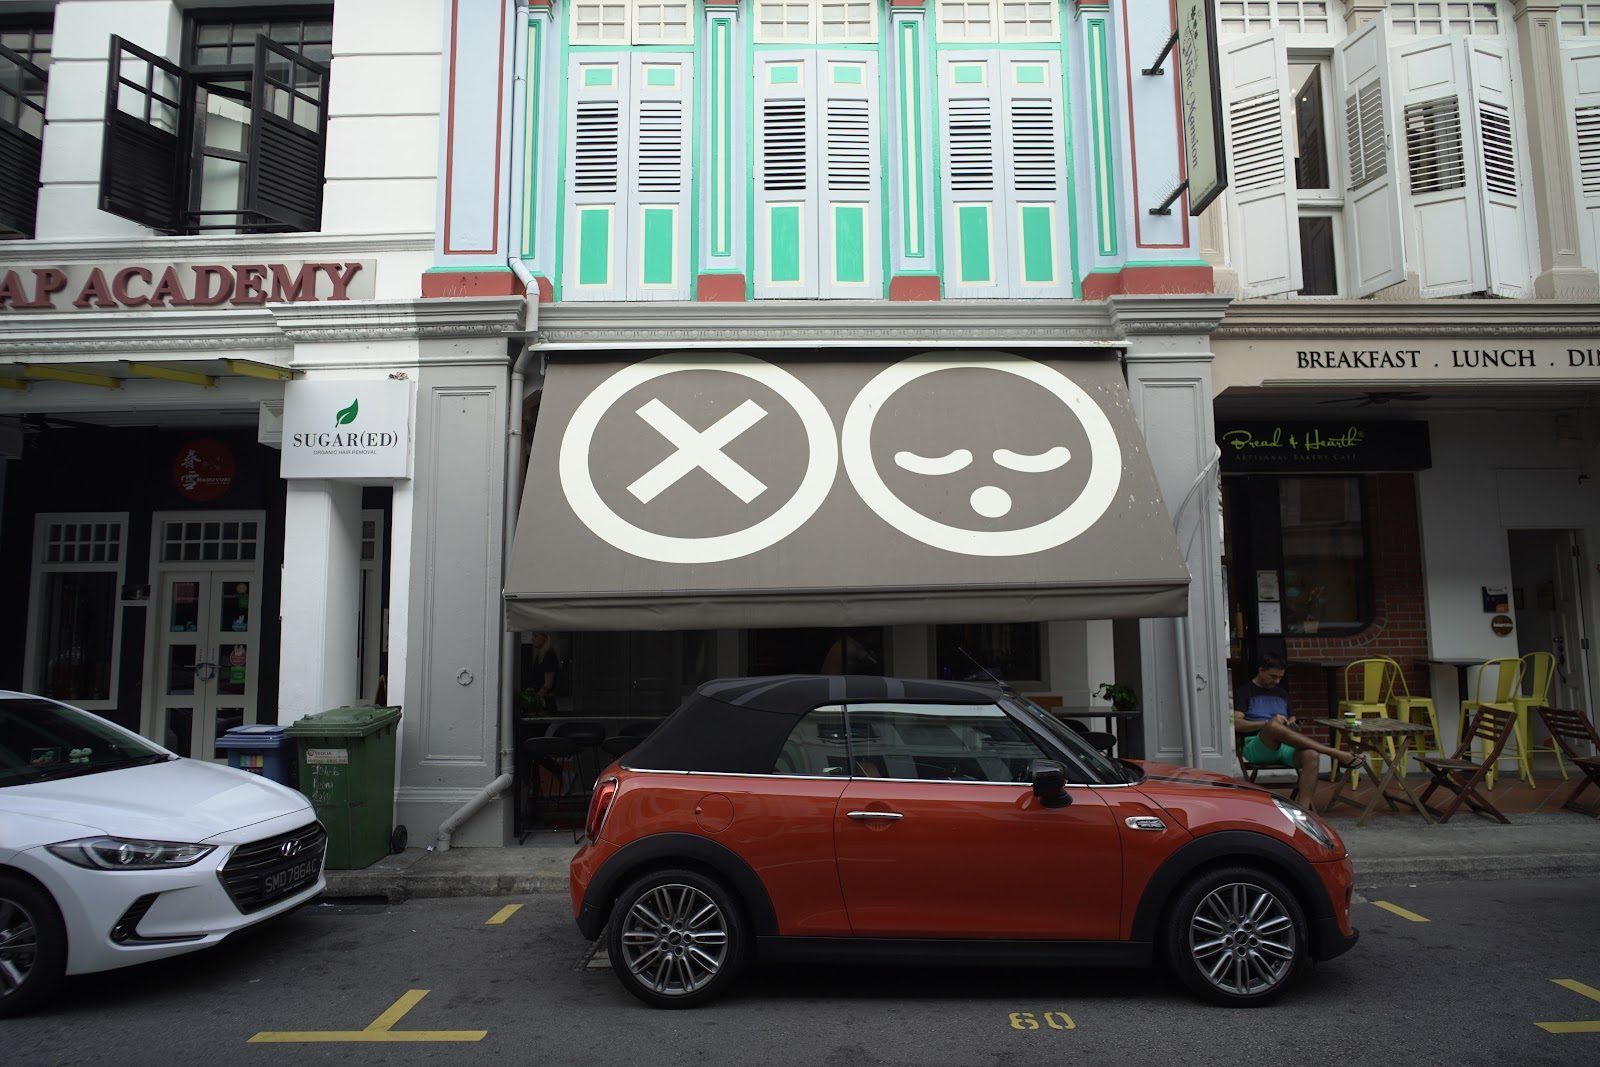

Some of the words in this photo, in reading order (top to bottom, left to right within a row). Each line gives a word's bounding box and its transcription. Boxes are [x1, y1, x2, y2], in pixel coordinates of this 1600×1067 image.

[1186, 91, 1198, 168] Mansion
[0, 267, 68, 309] AP
[73, 262, 363, 308] ACADEMY
[1296, 350, 1420, 369] BREAKFAST
[1452, 349, 1536, 368] LUNCH
[1566, 349, 1600, 366] DI
[293, 430, 398, 448] SUGAR(ED)
[1223, 427, 1283, 450] Bread
[1305, 426, 1363, 451] Hearth
[264, 870, 288, 893] SMD
[1008, 1012, 1076, 1030] 60
